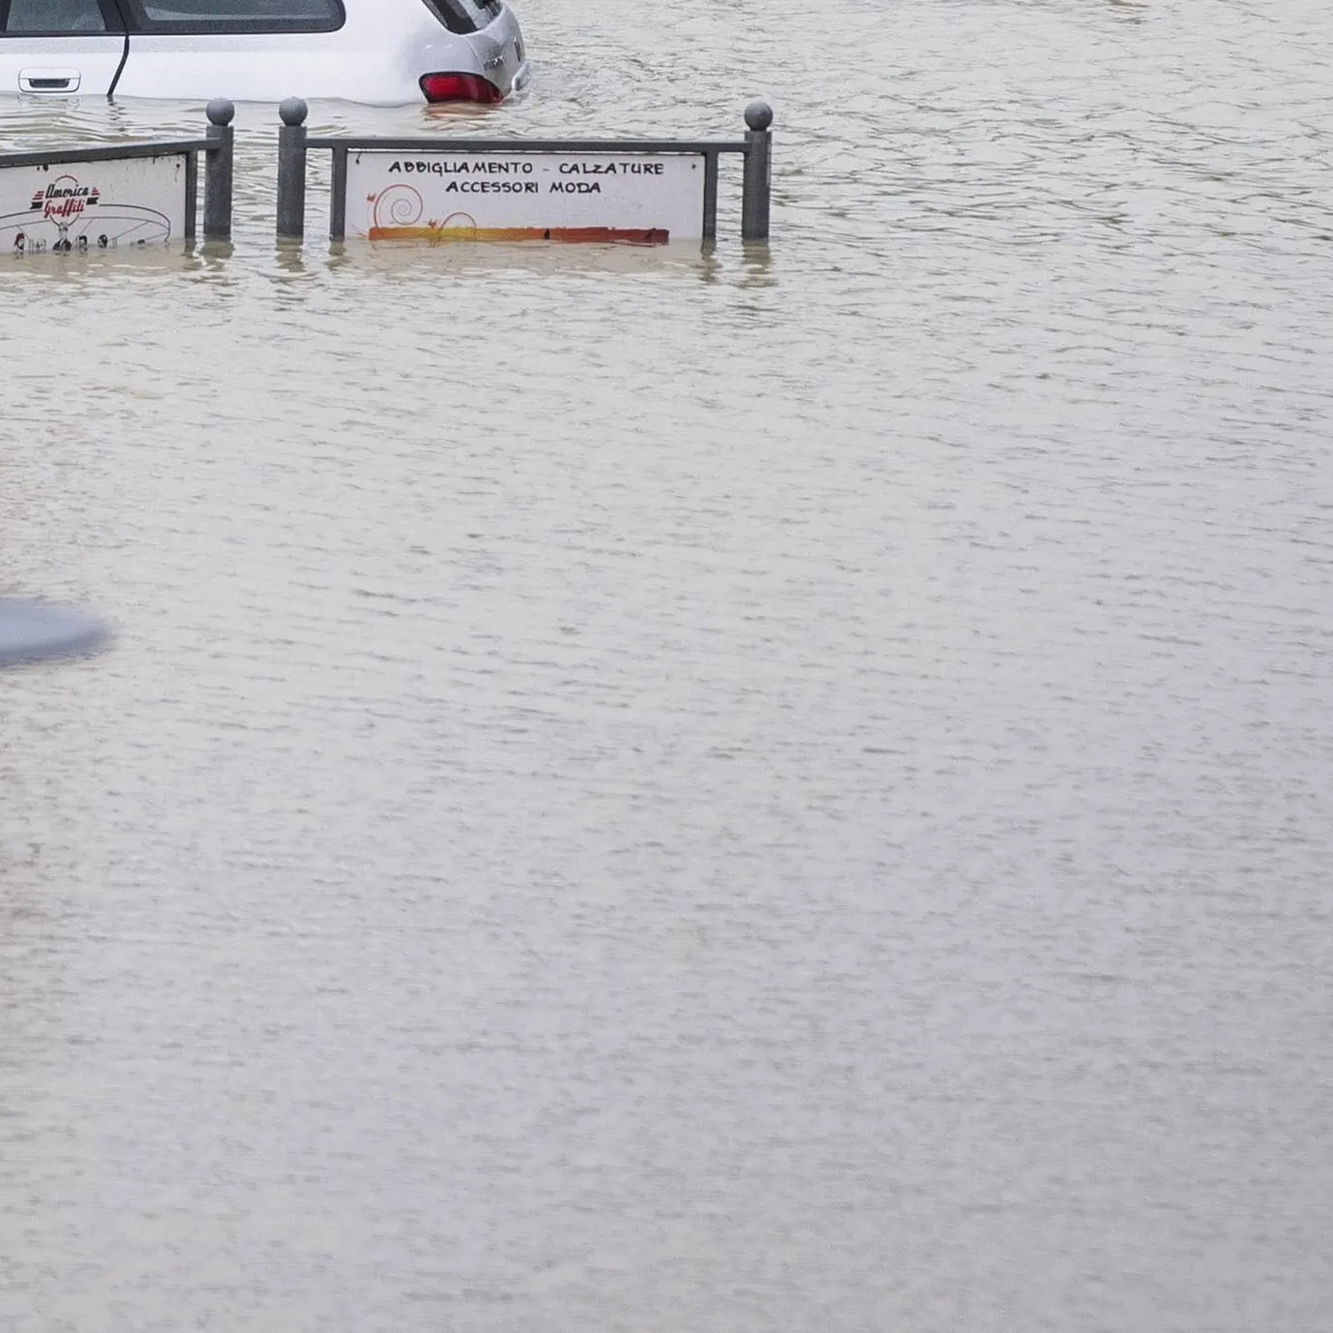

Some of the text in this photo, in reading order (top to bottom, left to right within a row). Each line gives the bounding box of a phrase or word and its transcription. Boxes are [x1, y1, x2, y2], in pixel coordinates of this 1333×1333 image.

[387, 161, 534, 177] ABBIGLIAMENTO
[558, 162, 665, 175] CALZATURE
[445, 181, 602, 194] ACCESSORI MODA
[43, 198, 86, 219] Graffiti
